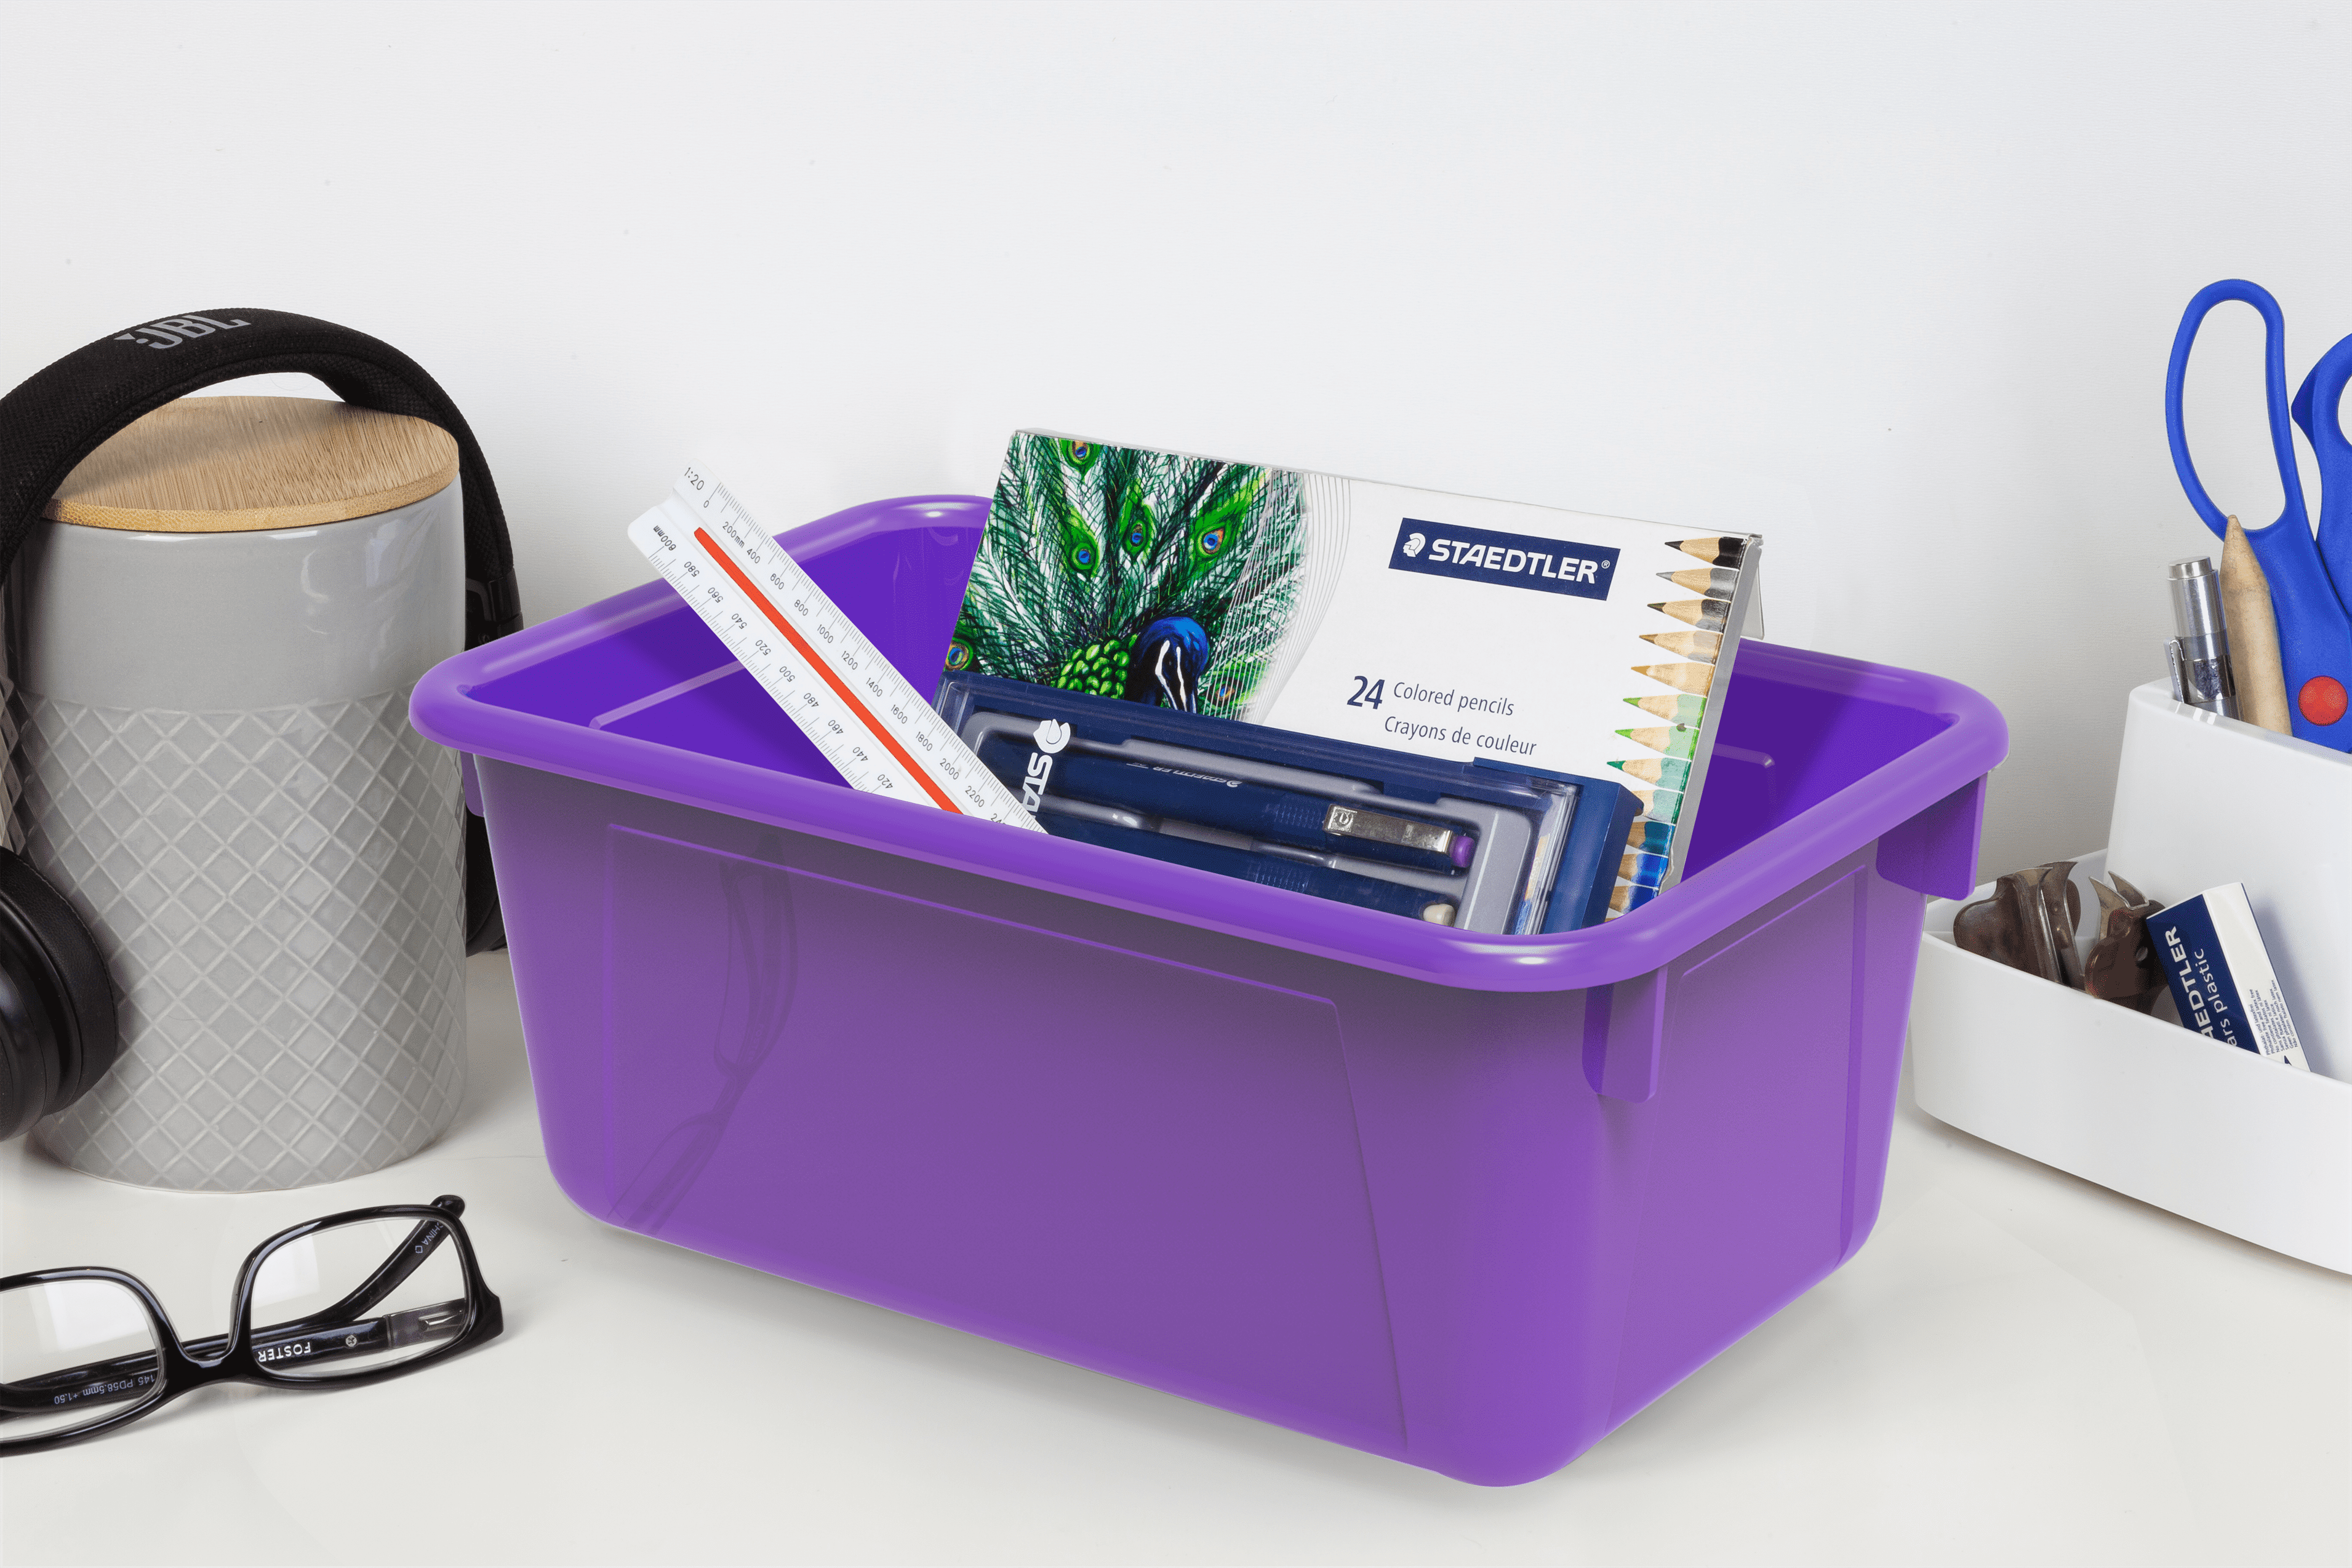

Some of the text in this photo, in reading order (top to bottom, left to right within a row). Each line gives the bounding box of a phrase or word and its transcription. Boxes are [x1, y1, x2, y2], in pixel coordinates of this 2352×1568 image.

[135, 314, 252, 349] JBL
[684, 466, 705, 491] 1:20
[653, 525, 894, 790] 420 440 460 480 500 520 540 560 580 600mm
[703, 500, 710, 508] 0
[722, 521, 745, 548] 200mm
[746, 548, 761, 564] 400
[770, 573, 785, 590] 600
[794, 599, 809, 616] 800
[817, 624, 834, 644] 1000
[841, 650, 858, 670] 1200
[865, 677, 883, 697] 1400
[890, 704, 908, 724] 1600
[915, 731, 933, 751] 1800
[940, 758, 959, 780] 2000
[965, 785, 985, 807] 2200
[1346, 675, 1514, 716] 24 Colored pencils
[1385, 716, 1537, 756] Crayons de couleur
[2194, 948, 2228, 1014] plastic
[257, 1342, 311, 1362] FOSTER
[54, 1374, 155, 1405] 145 PD58.5mm +1.50
